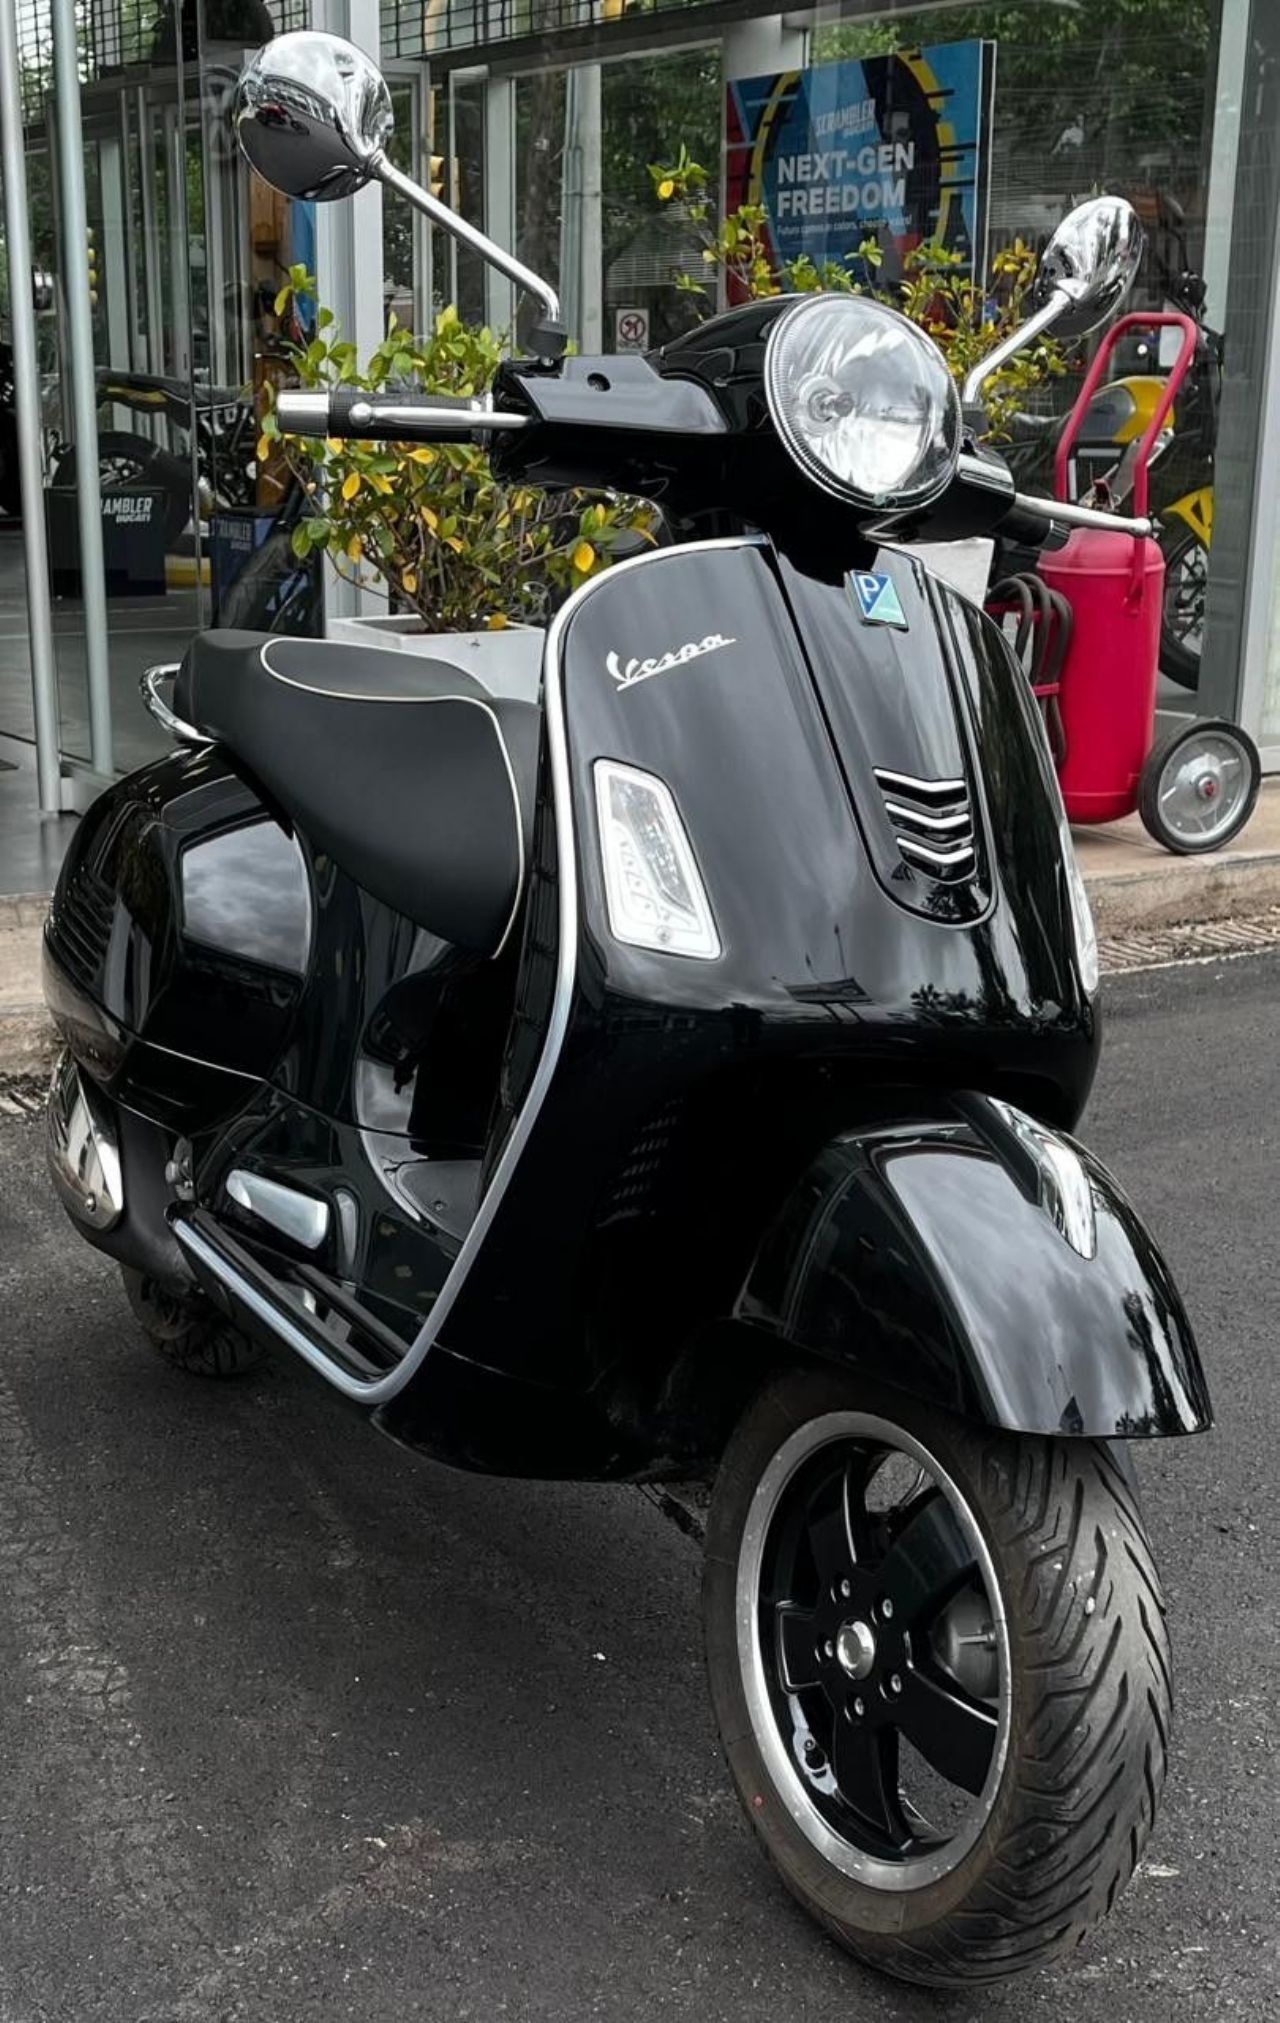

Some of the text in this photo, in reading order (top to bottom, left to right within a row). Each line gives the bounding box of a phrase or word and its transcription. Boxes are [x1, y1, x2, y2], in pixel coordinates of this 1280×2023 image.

[777, 141, 915, 184] NEXT-GEN
[777, 178, 906, 218] FREEDOM
[857, 575, 880, 603] P
[606, 634, 737, 691] Vespa
